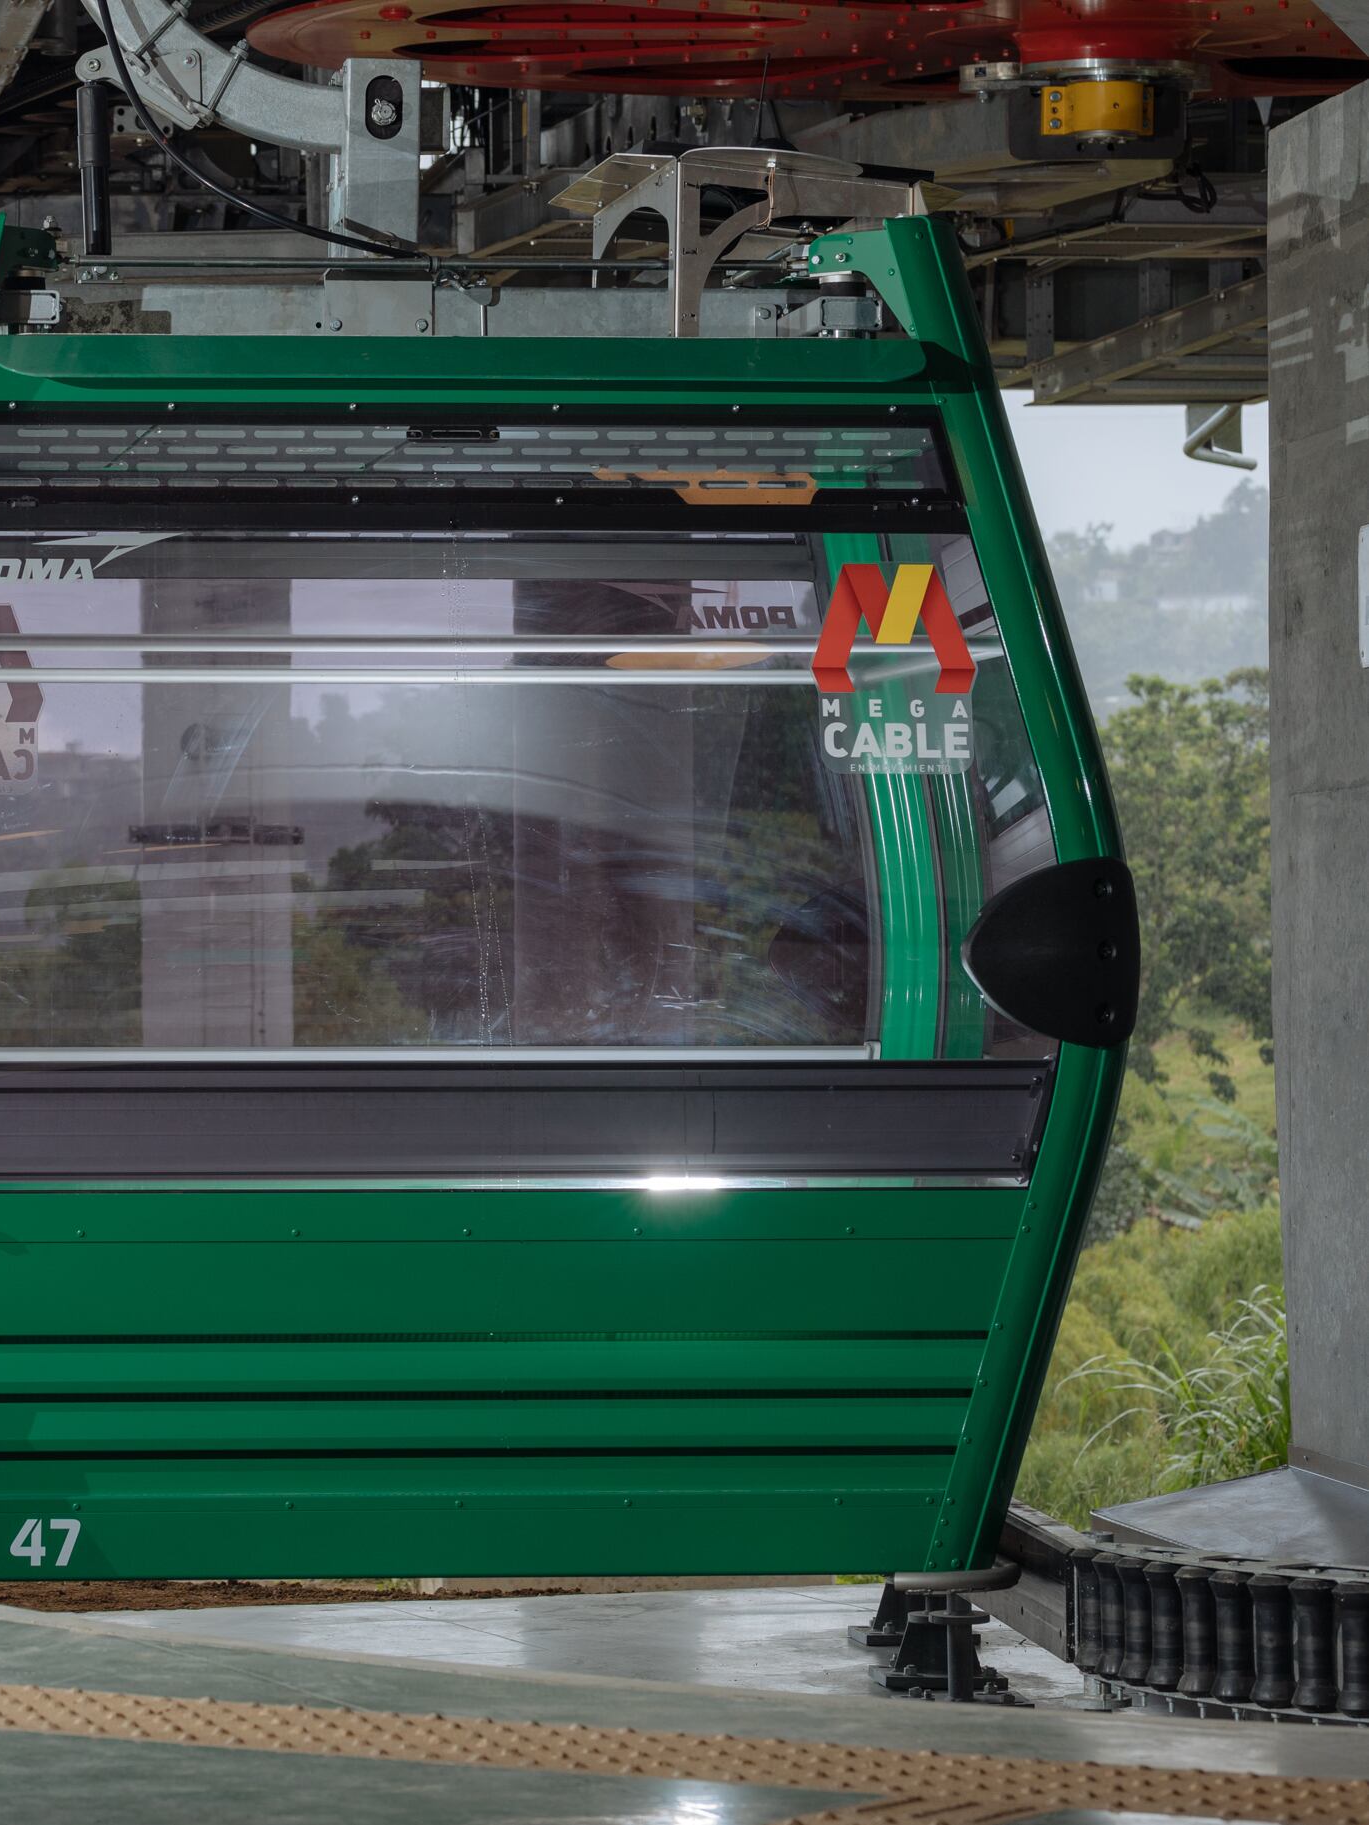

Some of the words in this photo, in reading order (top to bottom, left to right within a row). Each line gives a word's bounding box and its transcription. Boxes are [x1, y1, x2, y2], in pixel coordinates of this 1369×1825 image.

[821, 698, 969, 718] MEGA
[823, 722, 971, 759] CABLE
[849, 763, 866, 772] EN
[872, 763, 951, 773] MVMIENTO
[9, 1518, 82, 1567] 47
